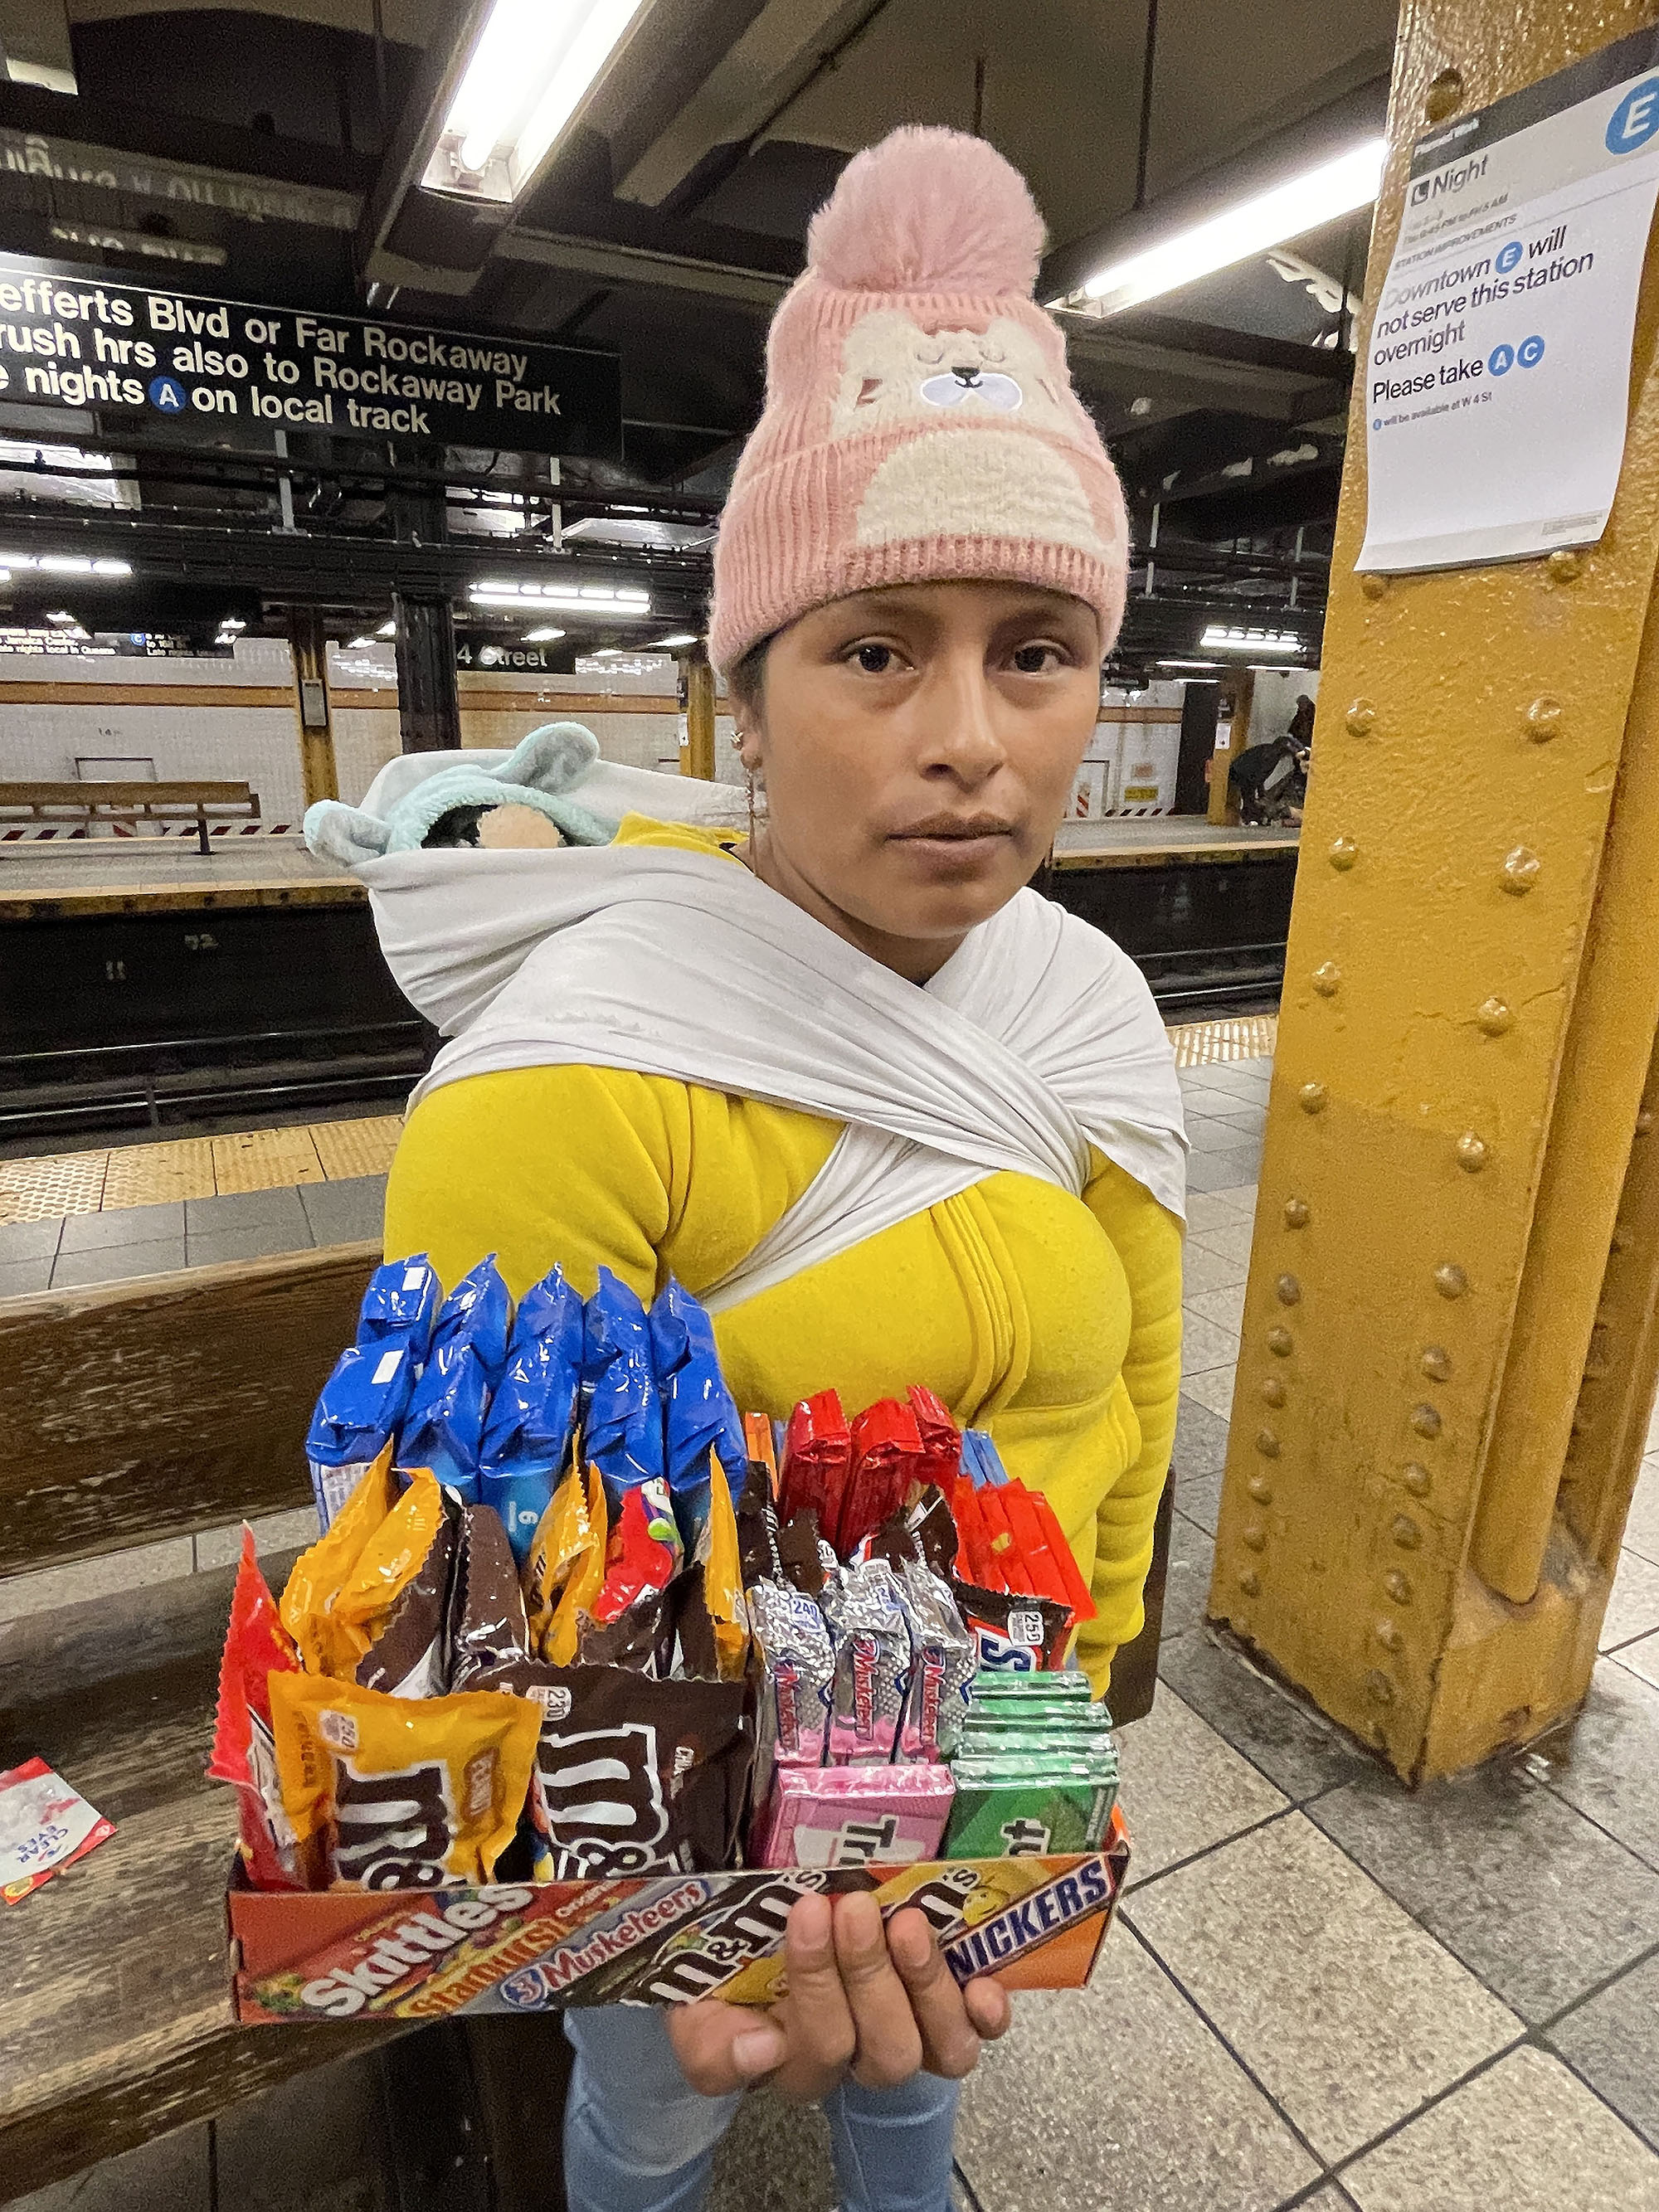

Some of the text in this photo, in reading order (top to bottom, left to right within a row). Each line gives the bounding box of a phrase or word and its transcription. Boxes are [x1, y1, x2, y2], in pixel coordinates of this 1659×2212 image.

[1622, 91, 1657, 139] E
[1432, 154, 1489, 199] Night
[1376, 252, 1593, 338] not serve this station
[1383, 226, 1565, 311] Downtown E will
[0, 279, 528, 382] efferts Blvd or Far Rockaway
[1374, 319, 1466, 366] overnight
[25, 361, 145, 406] nights
[192, 386, 238, 414] on
[251, 386, 333, 424] local
[348, 398, 431, 435] track
[93, 328, 157, 368] hrs
[173, 341, 248, 378] also
[263, 352, 299, 384] to
[314, 356, 482, 411] Rockaway
[496, 379, 562, 415] Park
[1373, 372, 1436, 404] Please
[1438, 357, 1484, 386] take
[1462, 396, 1472, 407] W
[1473, 395, 1480, 404] 4
[457, 643, 472, 664] 4
[300, 1885, 533, 2016] Skittles
[541, 1882, 703, 1989] Musketeers
[945, 1860, 1109, 1981] NICKERS
